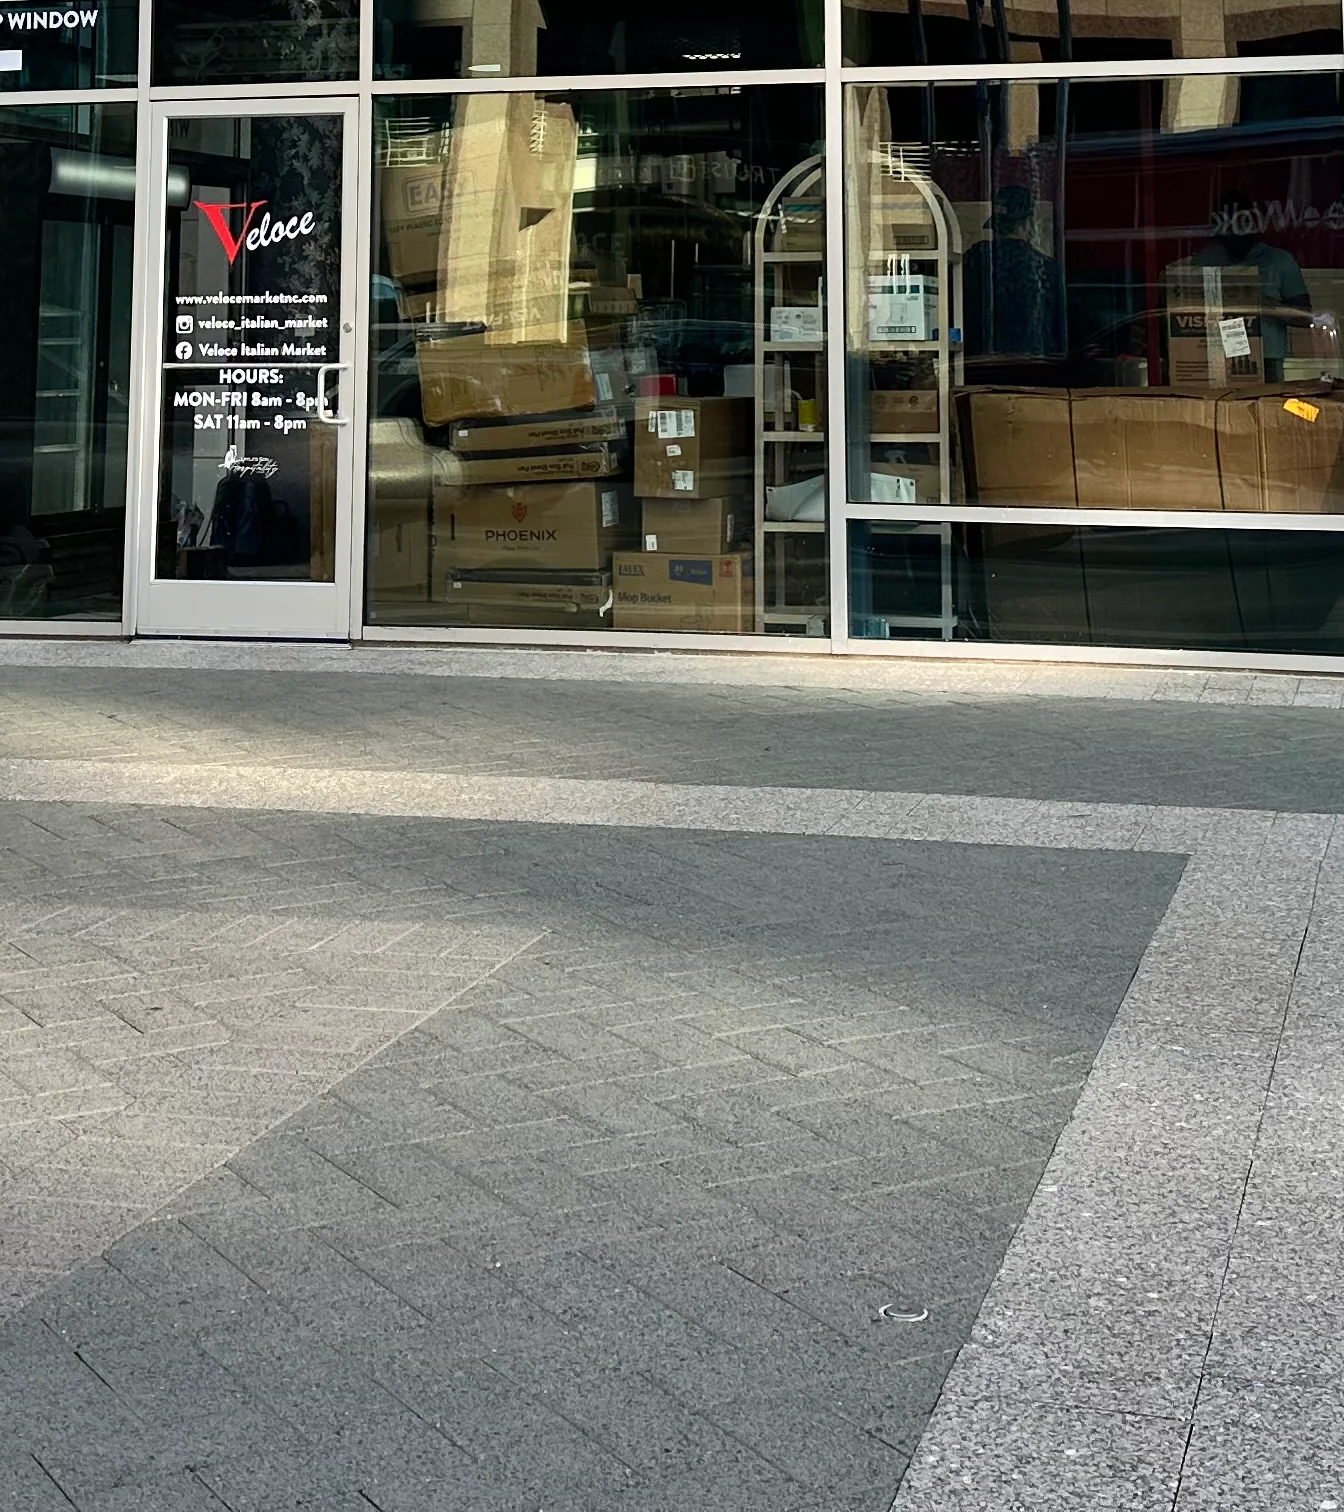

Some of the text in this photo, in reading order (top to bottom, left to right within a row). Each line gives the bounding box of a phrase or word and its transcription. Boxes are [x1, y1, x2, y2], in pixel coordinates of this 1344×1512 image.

[7, 9, 99, 30] WINDOW
[193, 200, 315, 265] Veloce
[175, 291, 327, 305] www.velocemarketnc.com
[198, 315, 328, 331] veloce_italian_market
[199, 343, 327, 356] Veloce Italian Market
[219, 368, 284, 384] HOURS:
[173, 391, 248, 407] MON-FRI
[251, 391, 282, 407] 8am
[193, 414, 223, 429] SAT
[226, 414, 260, 429] 11am
[274, 414, 307, 434] 8pm
[485, 529, 558, 541] PHOENIX
[618, 591, 672, 605] Mop Bucket
